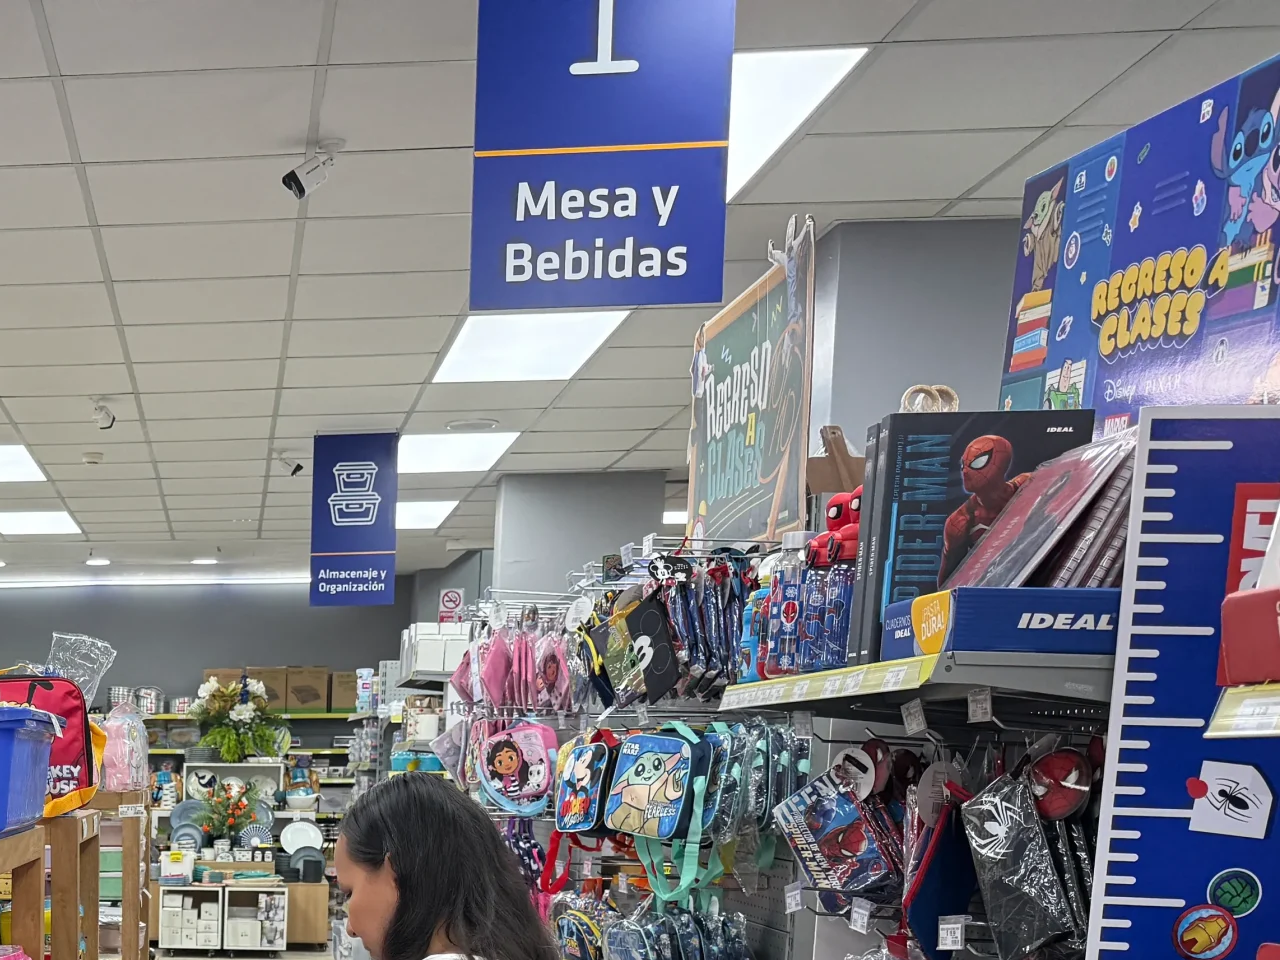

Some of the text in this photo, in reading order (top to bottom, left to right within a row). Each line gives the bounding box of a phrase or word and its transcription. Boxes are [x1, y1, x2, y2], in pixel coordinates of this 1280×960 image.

[516, 181, 680, 227] Mesa y
[505, 236, 688, 282] Bebidas
[1091, 247, 1230, 321] REGRESO A
[1099, 292, 1206, 357] CLASES
[706, 340, 772, 443] REGRESO
[1104, 373, 1181, 404] Disney PIXAR
[746, 412, 756, 447] A
[706, 421, 766, 506] CLASES
[893, 434, 952, 603] PIDER-MAN
[318, 568, 387, 581] Almacenaje y
[318, 581, 385, 595] Organización
[894, 627, 911, 640] IDEAL
[921, 611, 945, 641] DURA!
[1017, 612, 1115, 631] IDEAL
[622, 748, 640, 756] WARS
[623, 742, 640, 750] STAR
[48, 765, 81, 779] KEY
[643, 804, 677, 819] FEARLESS
